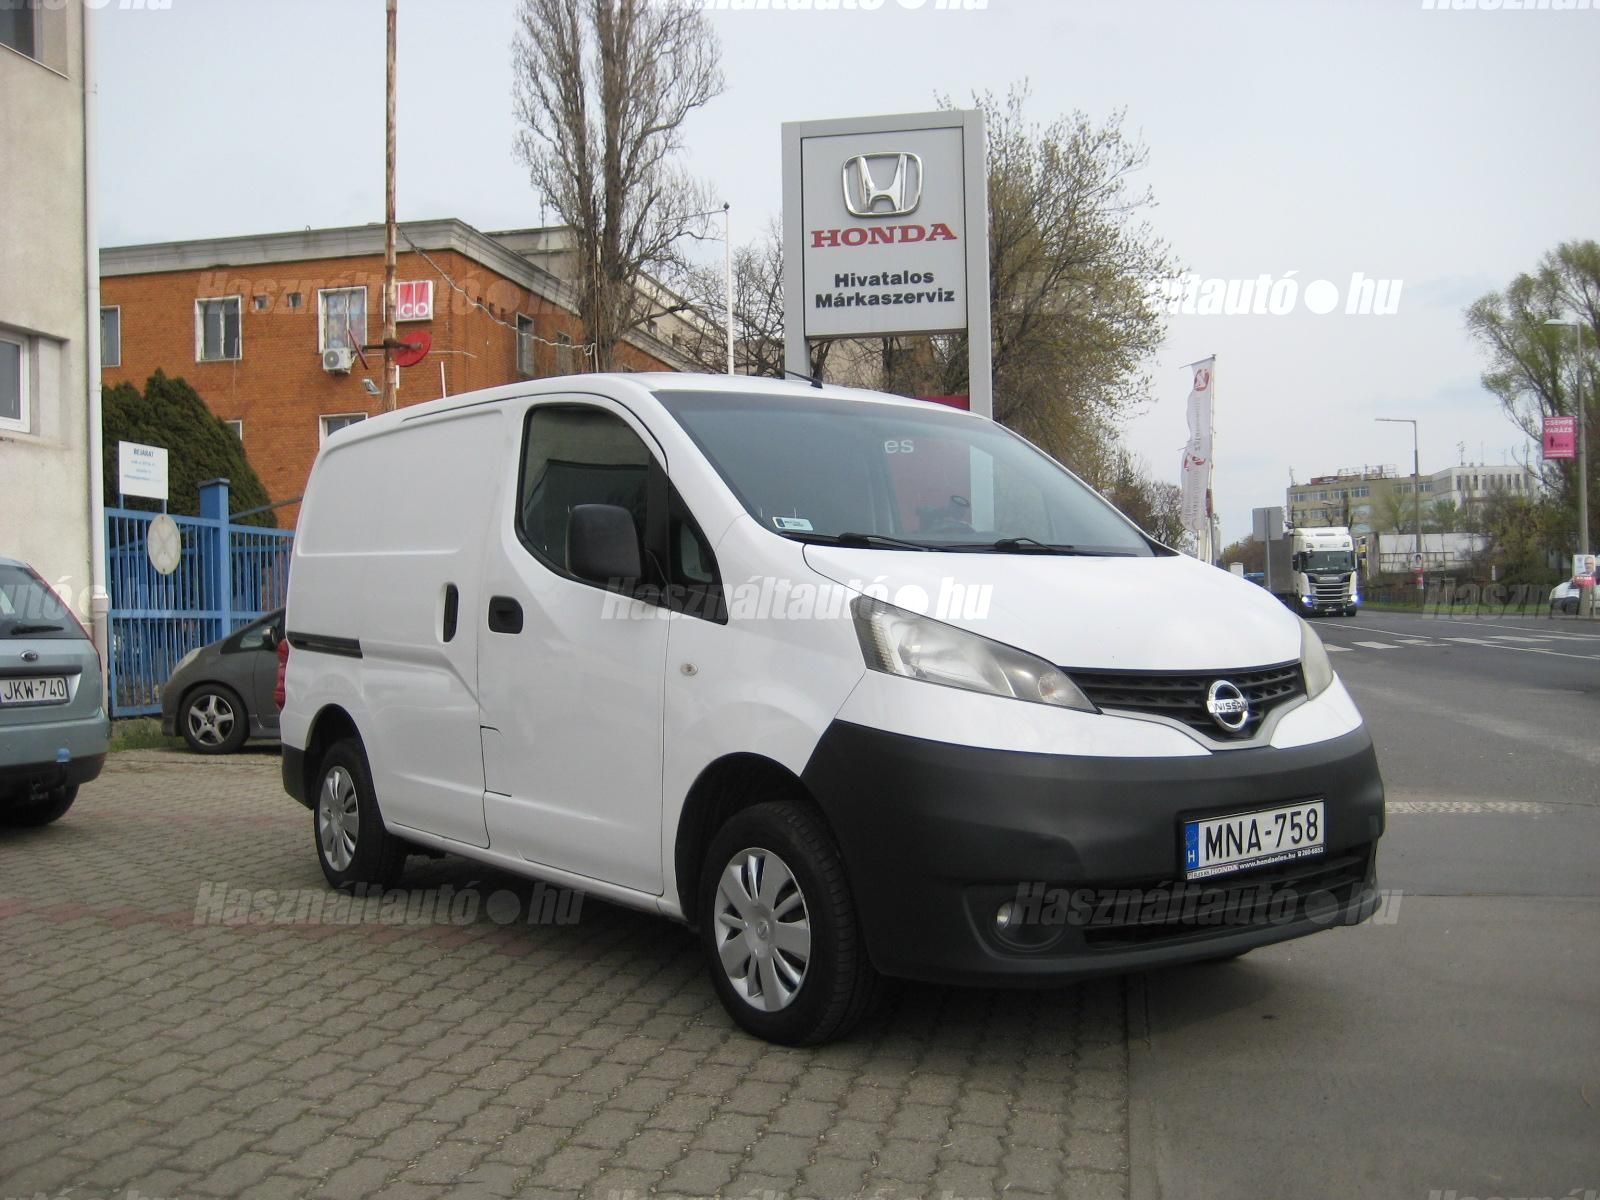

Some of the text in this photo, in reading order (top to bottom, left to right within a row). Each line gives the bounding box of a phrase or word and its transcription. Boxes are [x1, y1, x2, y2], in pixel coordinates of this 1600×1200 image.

[811, 223, 957, 248] HONDA
[834, 270, 934, 288] Hivatalos
[815, 288, 955, 308] Márkaszerviz
[4, 679, 65, 700] JKW-740
[1214, 700, 1247, 711] NISSAN
[1205, 808, 1318, 861] MNA-758
[1187, 850, 1195, 863] H
